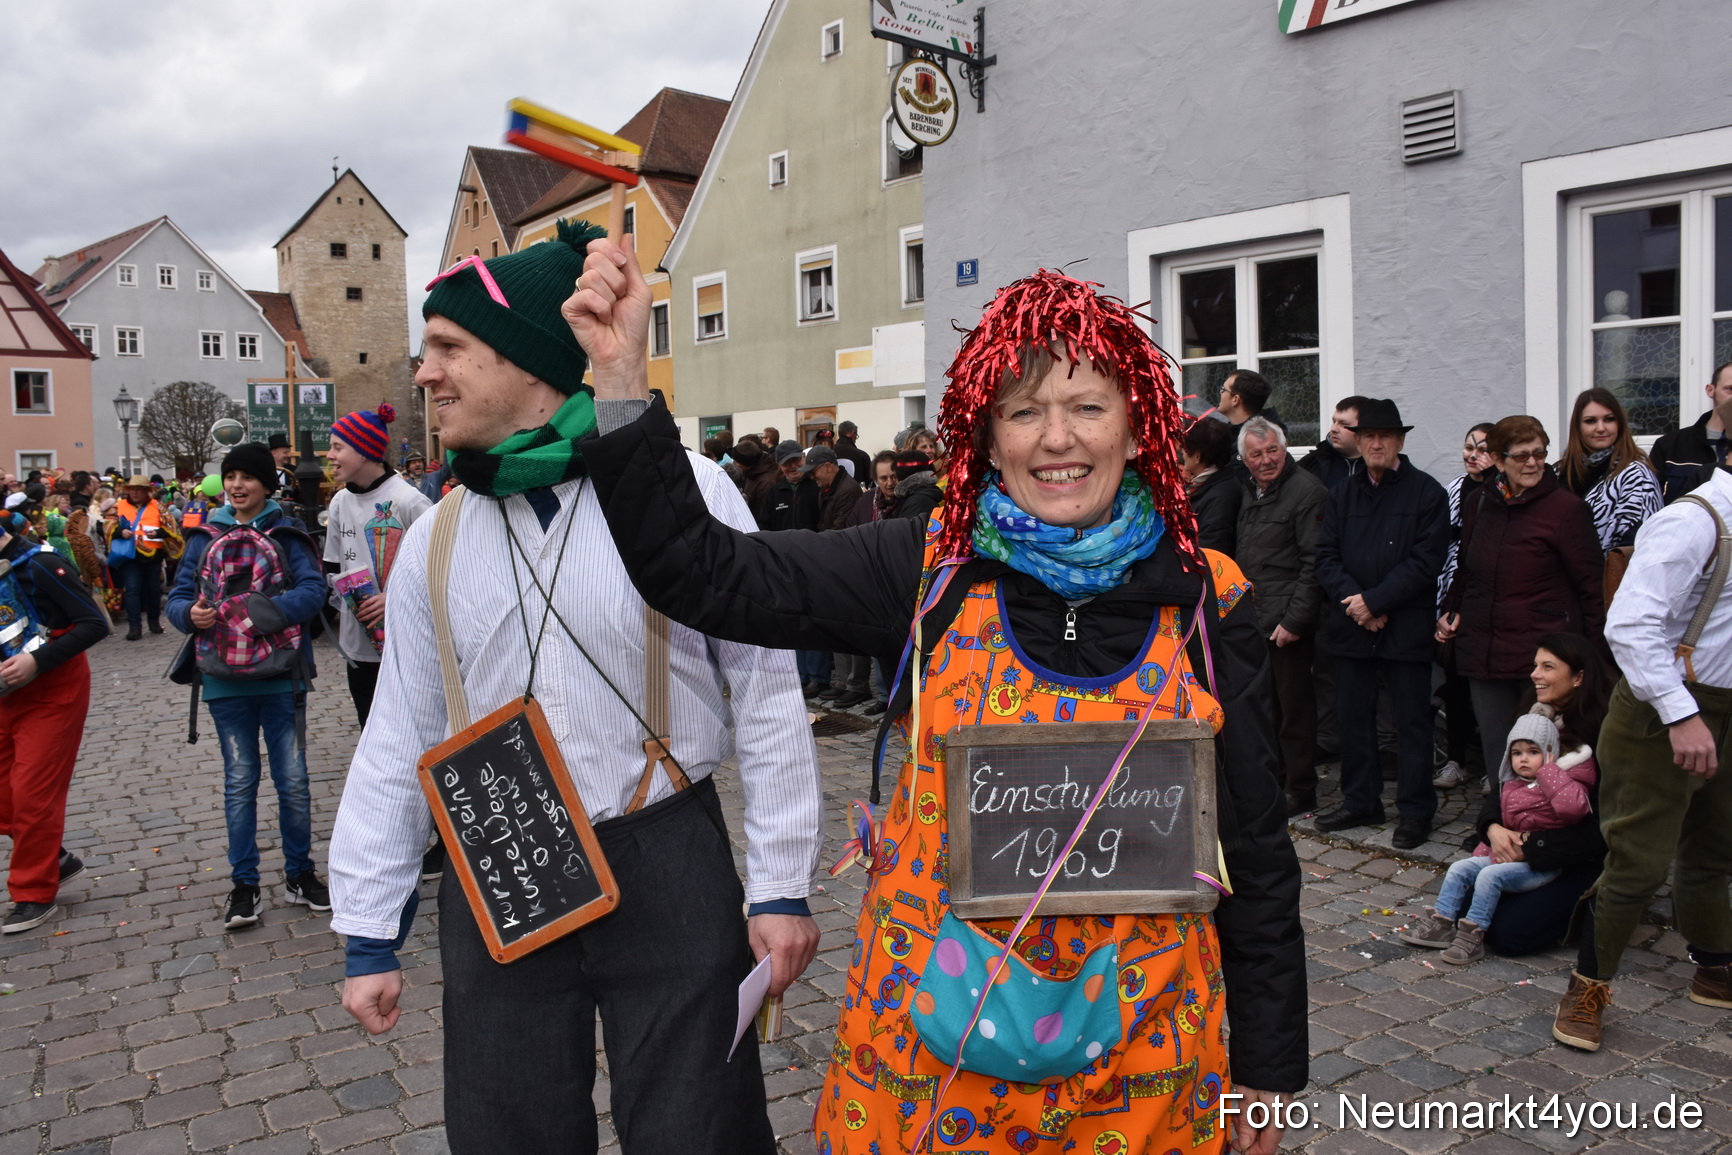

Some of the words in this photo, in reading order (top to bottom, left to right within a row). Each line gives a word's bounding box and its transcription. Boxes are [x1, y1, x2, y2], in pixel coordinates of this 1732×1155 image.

[900, 1, 923, 13] Pizzeria
[878, 16, 922, 36] Roma
[906, 13, 945, 32] Bella
[915, 66, 937, 78] WINKLER
[911, 121, 941, 137] BERCHING
[962, 262, 972, 276] 19
[443, 764, 486, 847] Beine
[480, 761, 514, 845] Wege
[970, 762, 1186, 838] Einschulung
[991, 827, 1124, 879] 1969
